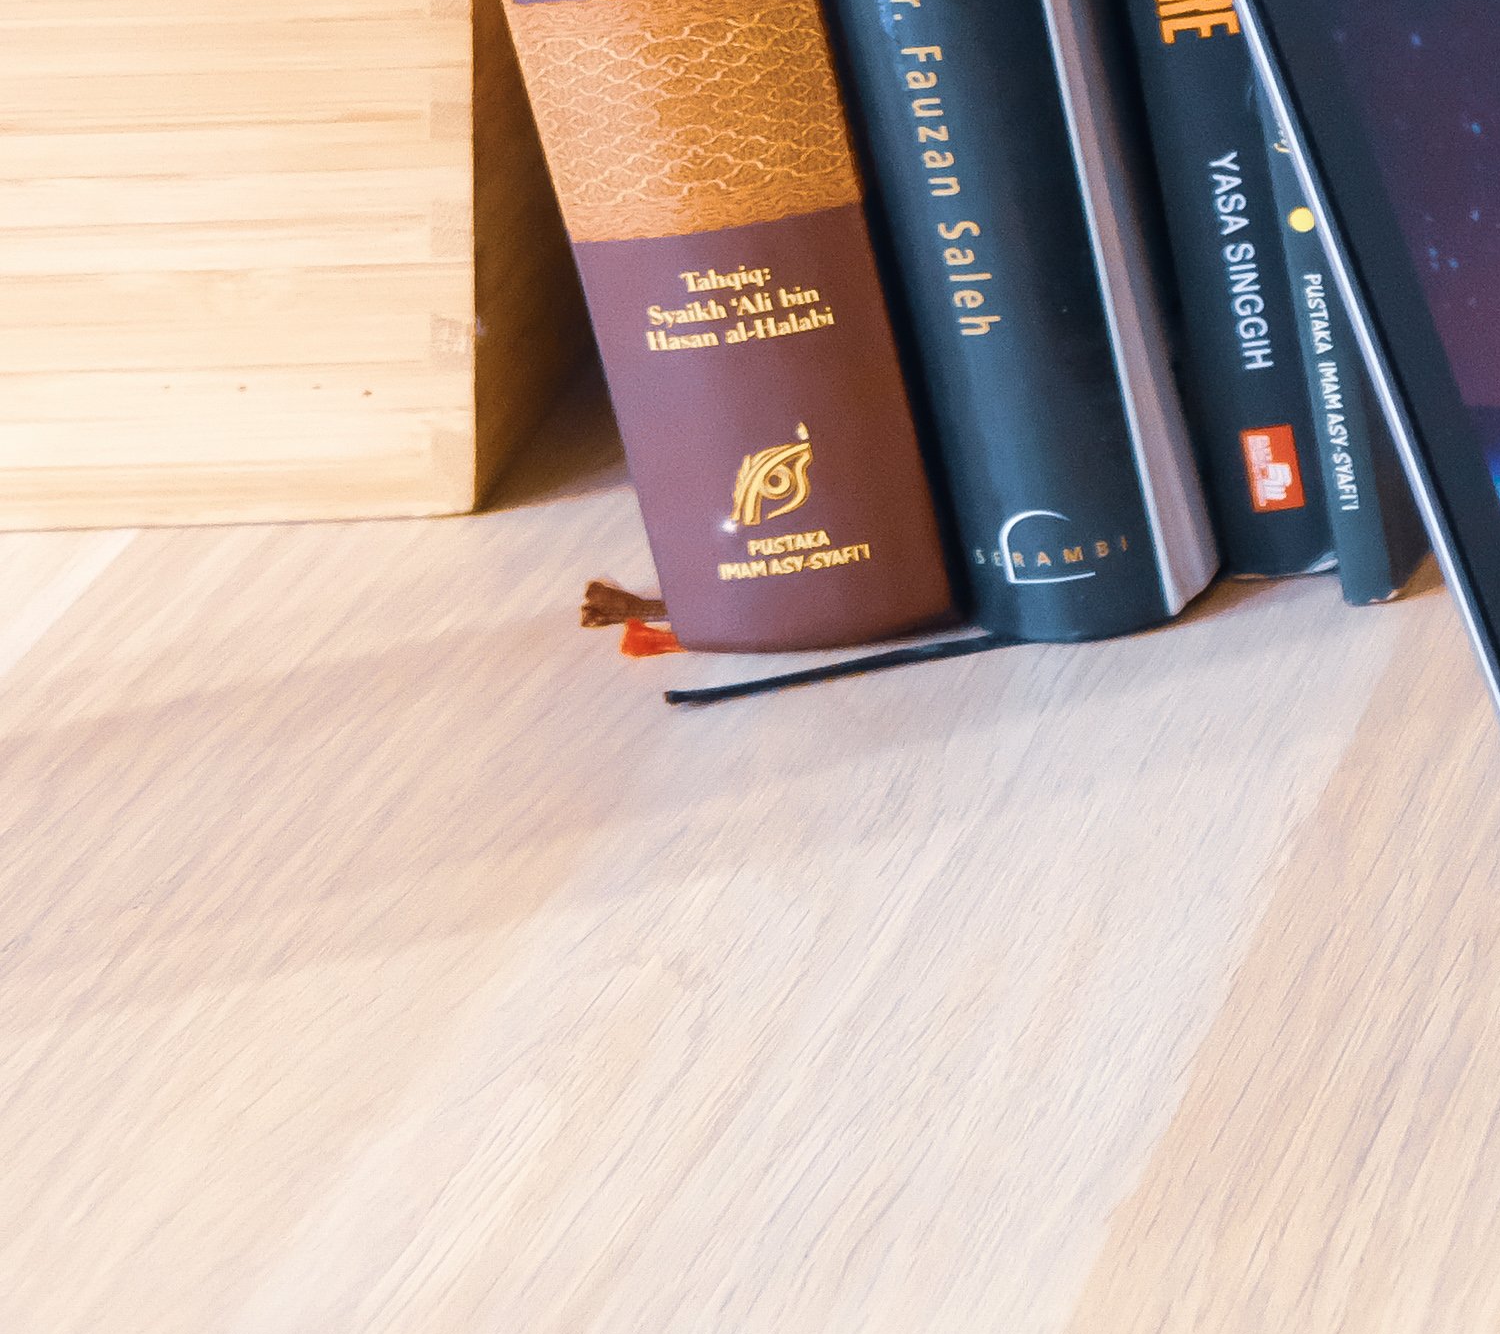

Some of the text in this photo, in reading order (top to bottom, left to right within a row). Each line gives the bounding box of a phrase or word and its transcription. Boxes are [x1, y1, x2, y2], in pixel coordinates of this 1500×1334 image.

[900, 45, 961, 197] Fauzan
[937, 220, 1001, 336] Saleh
[679, 265, 772, 293] Tahqiq:
[1209, 151, 1276, 370] YASA SINGGIH
[646, 298, 728, 328] Syaikh
[779, 286, 821, 309] bin
[646, 306, 836, 352] Hasan al-Halabi
[1303, 273, 1334, 355] PUSTAKA
[1317, 361, 1344, 410] IMAM
[747, 530, 831, 557] PUSTAKA
[718, 560, 768, 581] IMAM
